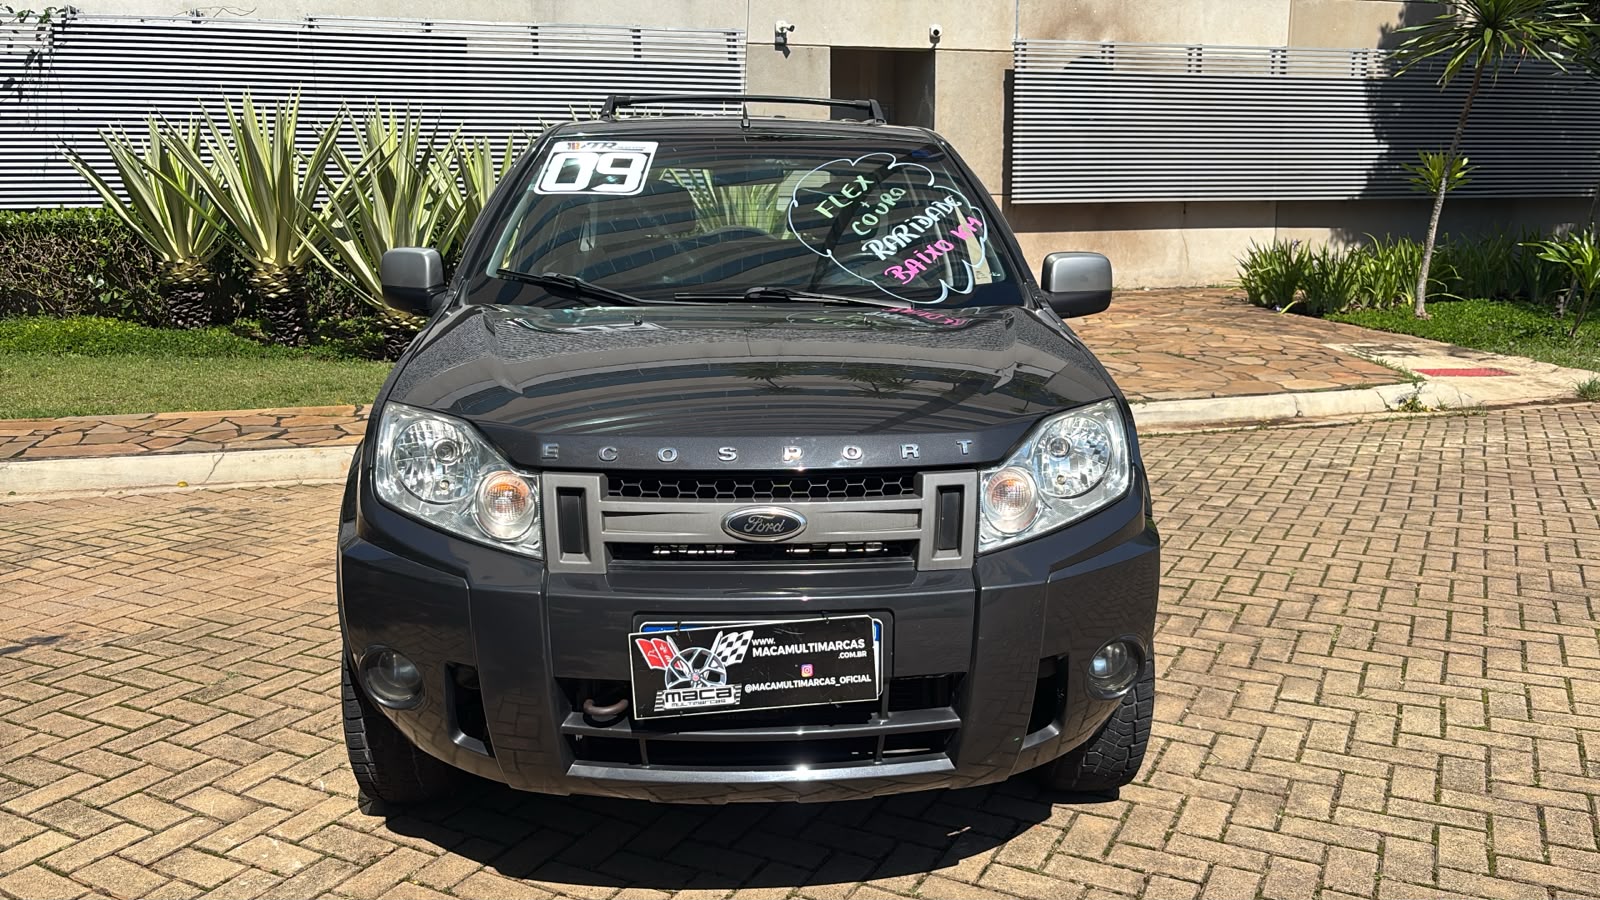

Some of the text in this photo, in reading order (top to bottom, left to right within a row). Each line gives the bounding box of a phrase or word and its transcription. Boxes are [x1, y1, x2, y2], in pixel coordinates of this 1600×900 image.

[539, 152, 649, 192] 09
[814, 175, 875, 219] FLEX
[851, 187, 906, 236] COURO
[950, 216, 983, 242] KM
[541, 440, 972, 461] ECOSPORT
[743, 514, 786, 533] Ford
[752, 639, 866, 657] MACAMULTIMARCAS
[838, 651, 868, 659] .COM.BR
[744, 674, 872, 694] @MACAMULTIMARCAS_OFICIAL
